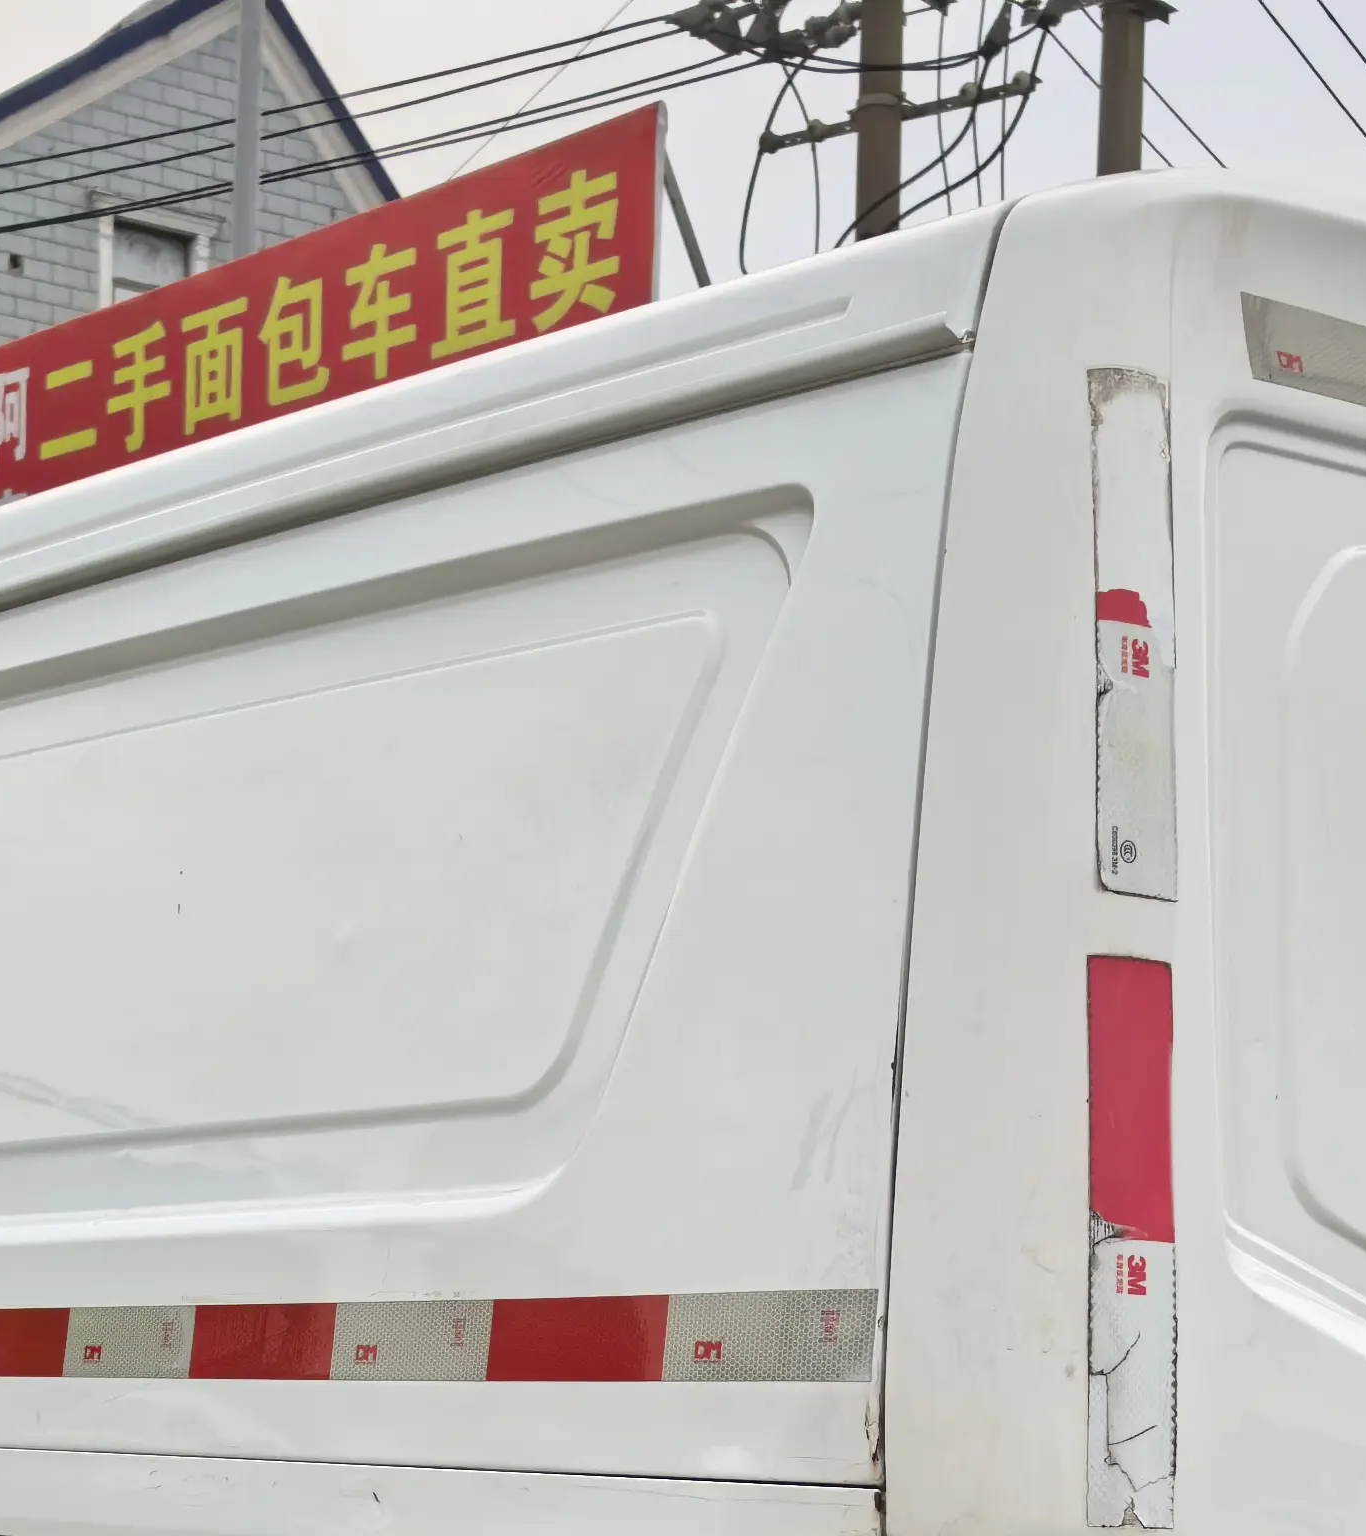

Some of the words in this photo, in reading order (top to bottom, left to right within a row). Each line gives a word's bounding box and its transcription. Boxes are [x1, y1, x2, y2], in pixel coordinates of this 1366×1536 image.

[39, 168, 622, 460] 二手面包车直卖
[1131, 638, 1150, 678] 3M
[1127, 1254, 1147, 1295] 3M
